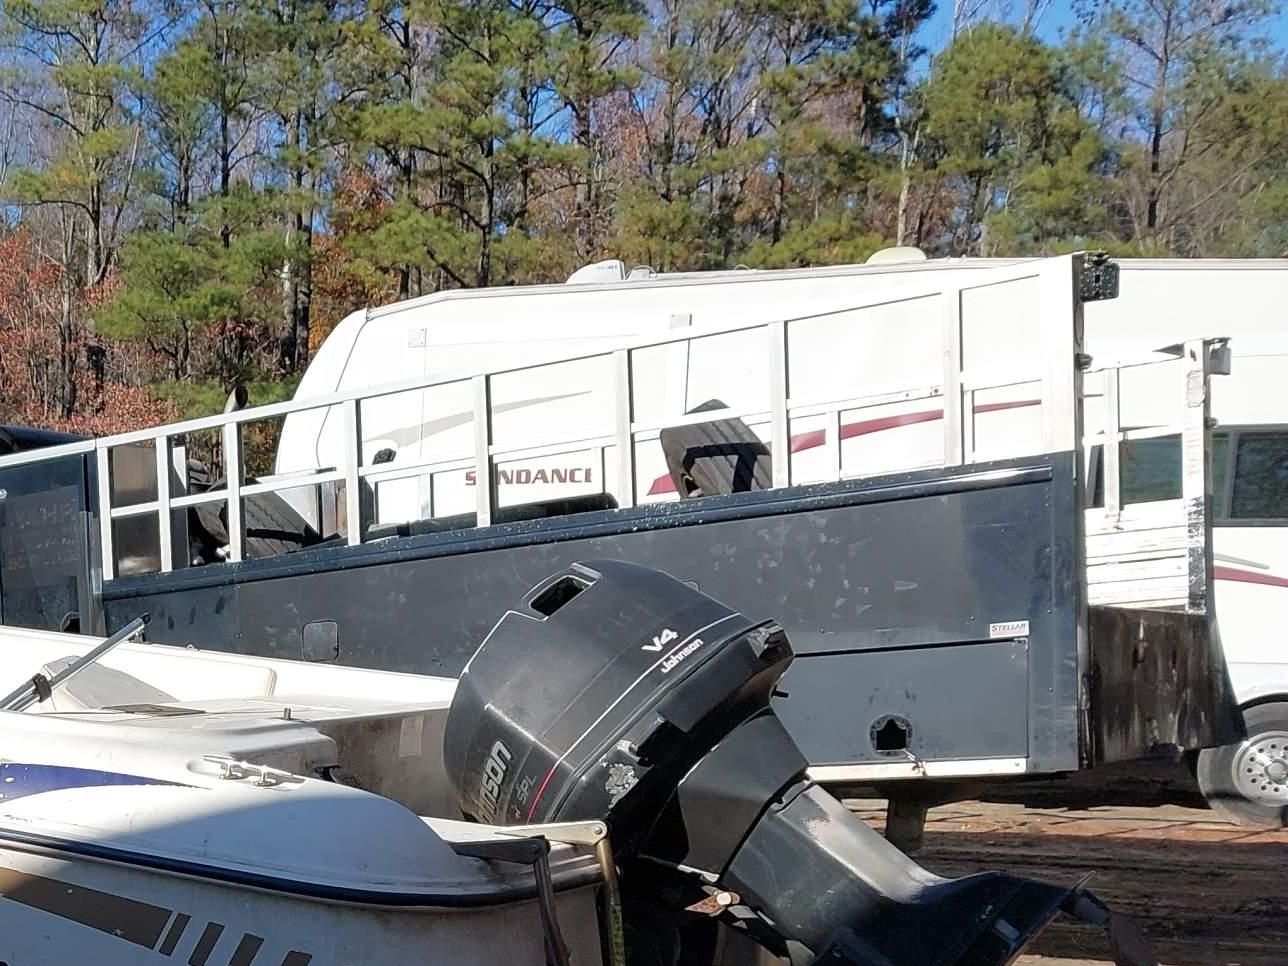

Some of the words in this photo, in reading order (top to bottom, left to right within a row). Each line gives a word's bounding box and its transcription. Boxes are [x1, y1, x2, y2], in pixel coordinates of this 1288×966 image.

[465, 466, 592, 486] SNDANC
[641, 628, 679, 652] V4
[660, 638, 704, 674] Johnson
